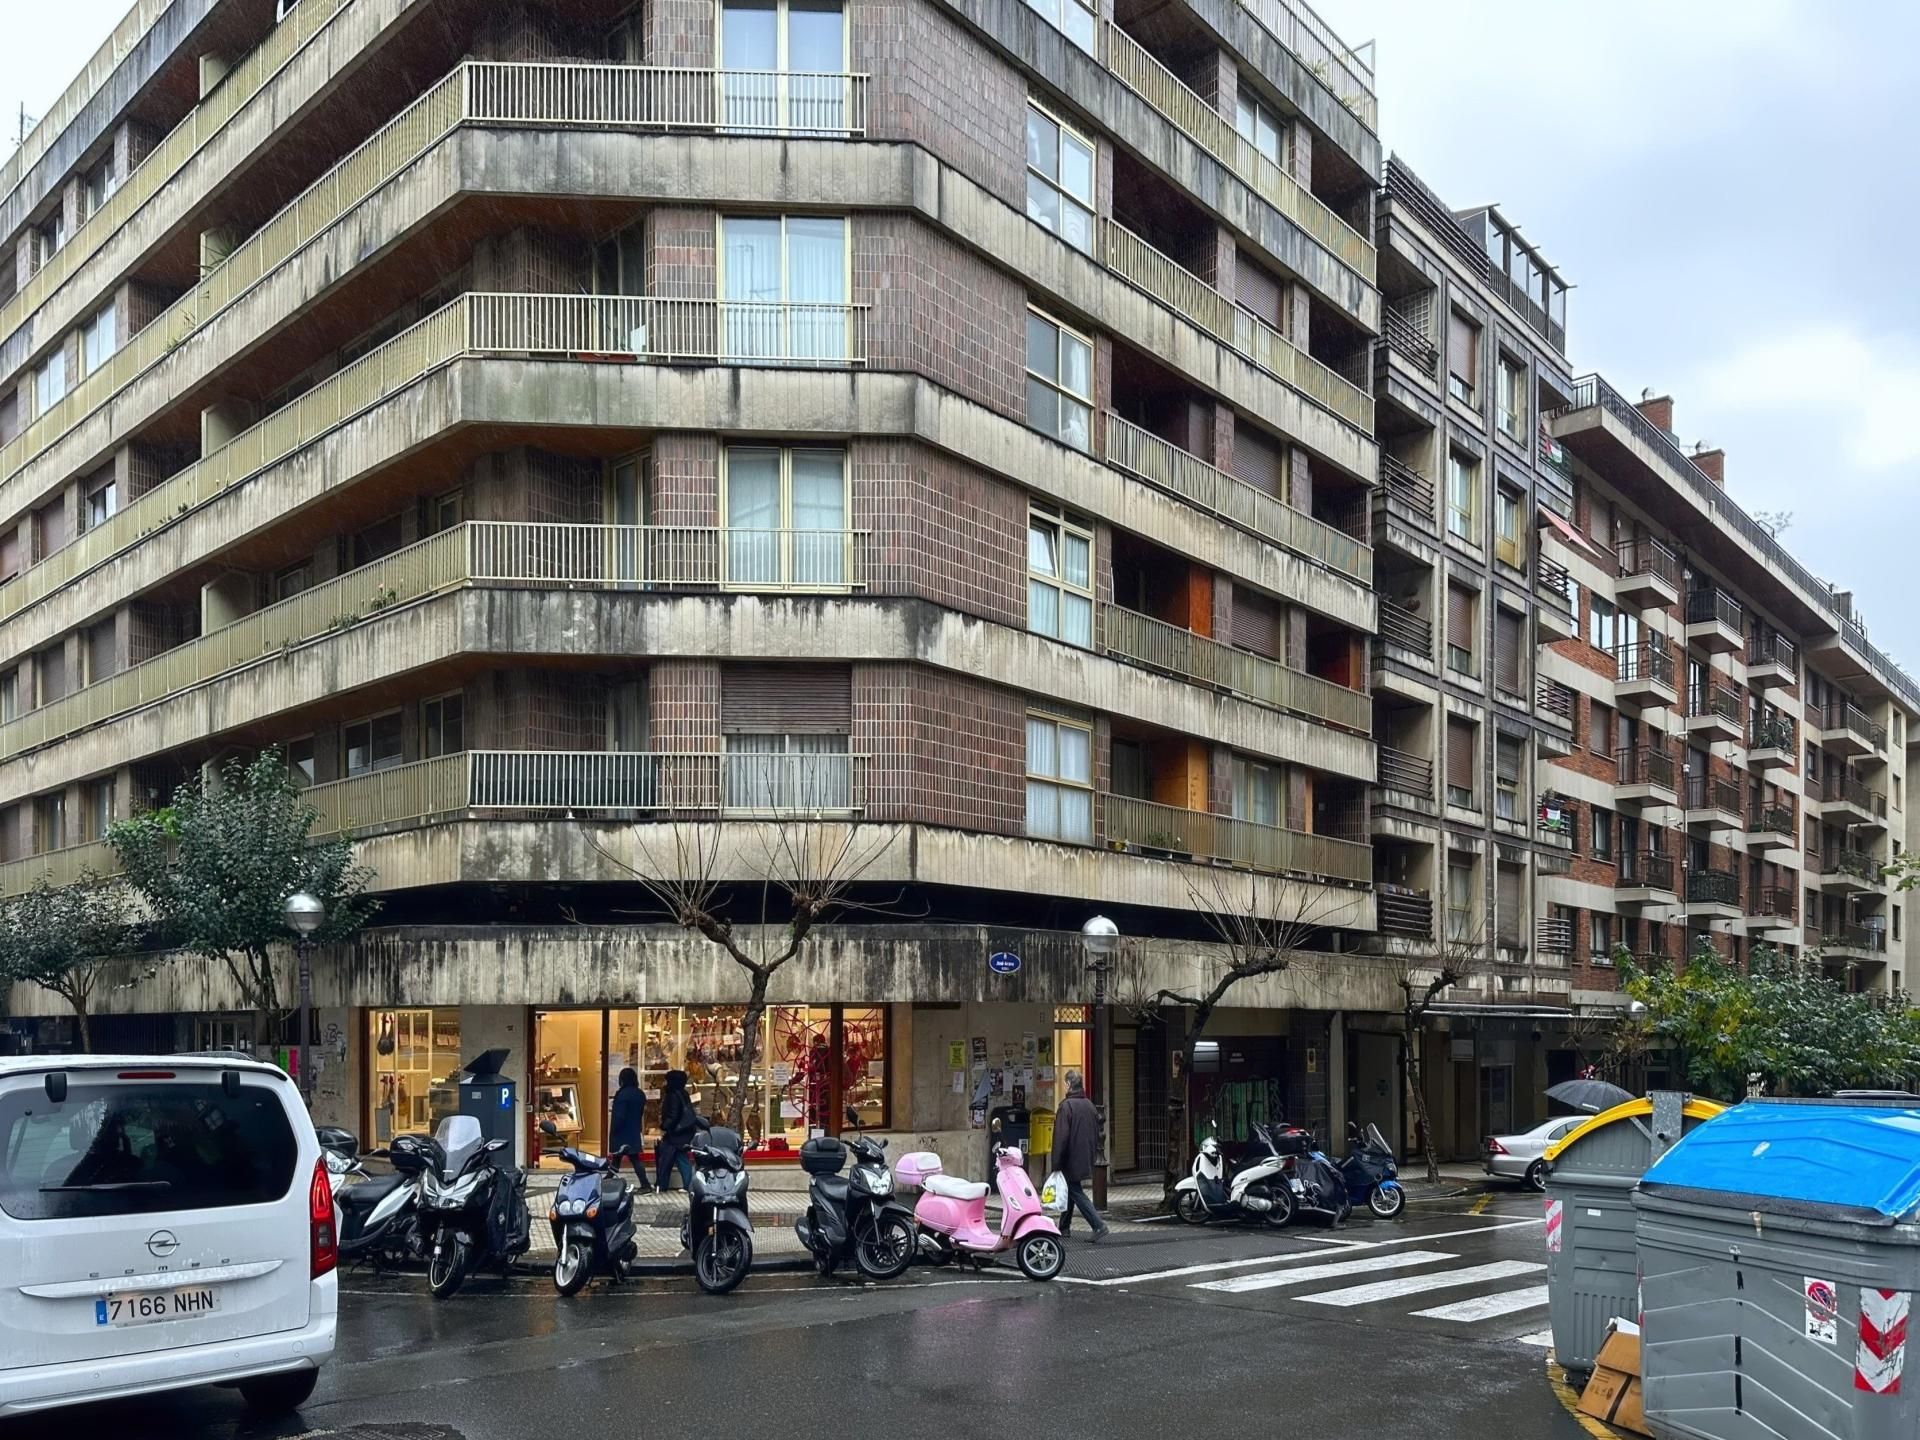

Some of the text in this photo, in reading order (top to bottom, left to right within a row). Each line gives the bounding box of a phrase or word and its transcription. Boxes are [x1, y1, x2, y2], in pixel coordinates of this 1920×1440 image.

[501, 1087, 509, 1105] P
[109, 1290, 214, 1321] 7166 NHN
